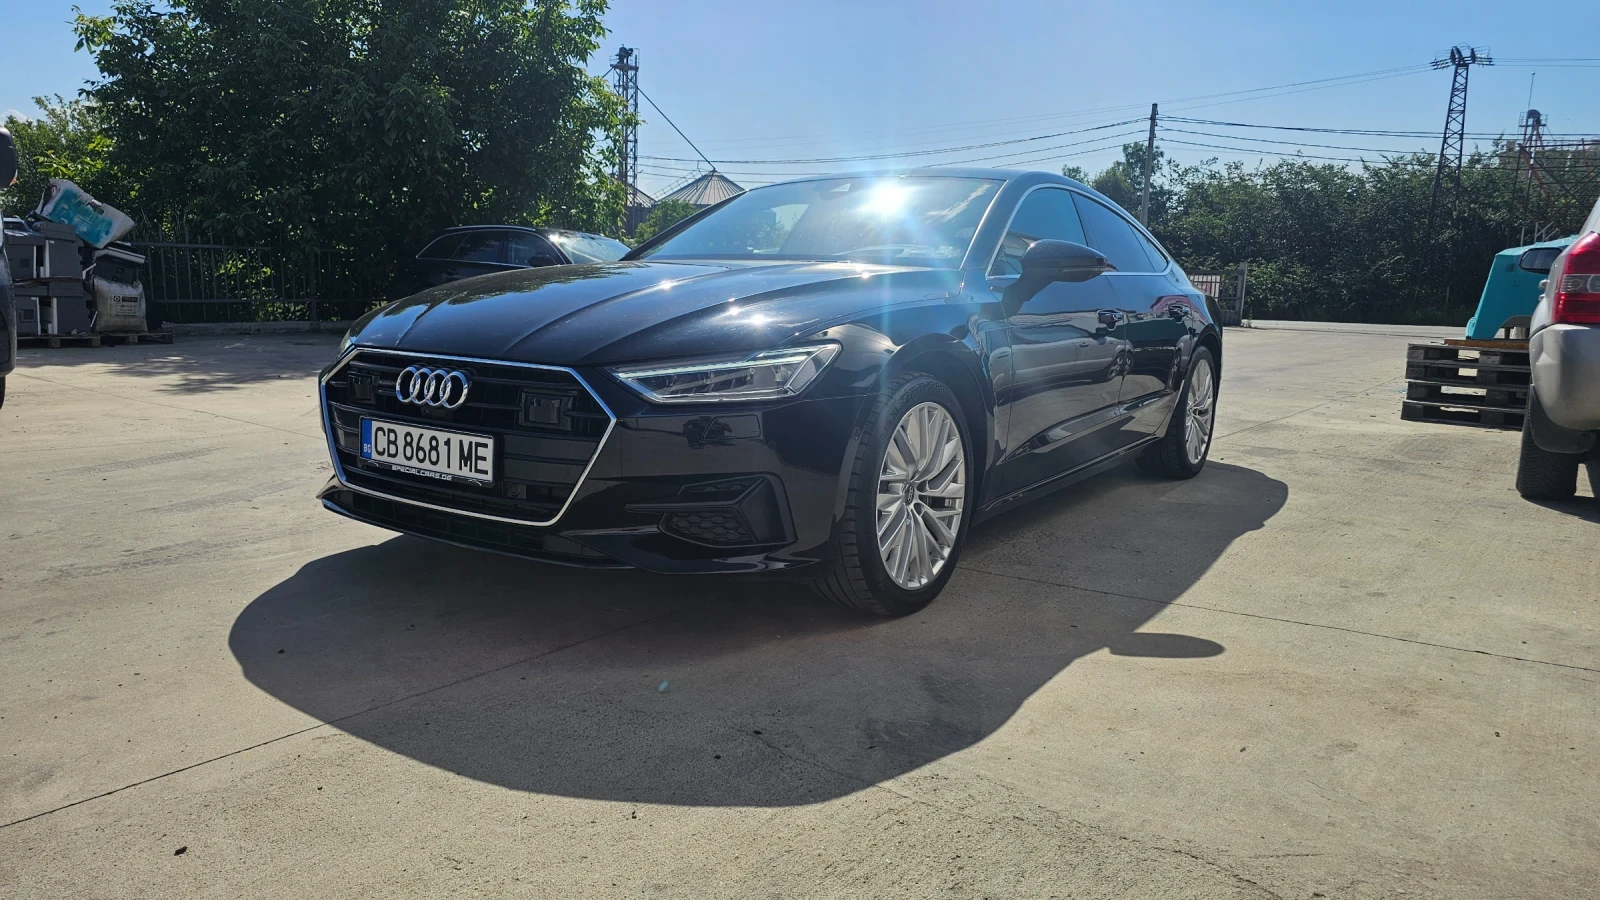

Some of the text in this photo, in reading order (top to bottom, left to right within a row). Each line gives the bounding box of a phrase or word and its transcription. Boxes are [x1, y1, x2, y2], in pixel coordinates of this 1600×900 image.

[363, 443, 372, 453] BG
[374, 426, 489, 475] CB 8681 ME
